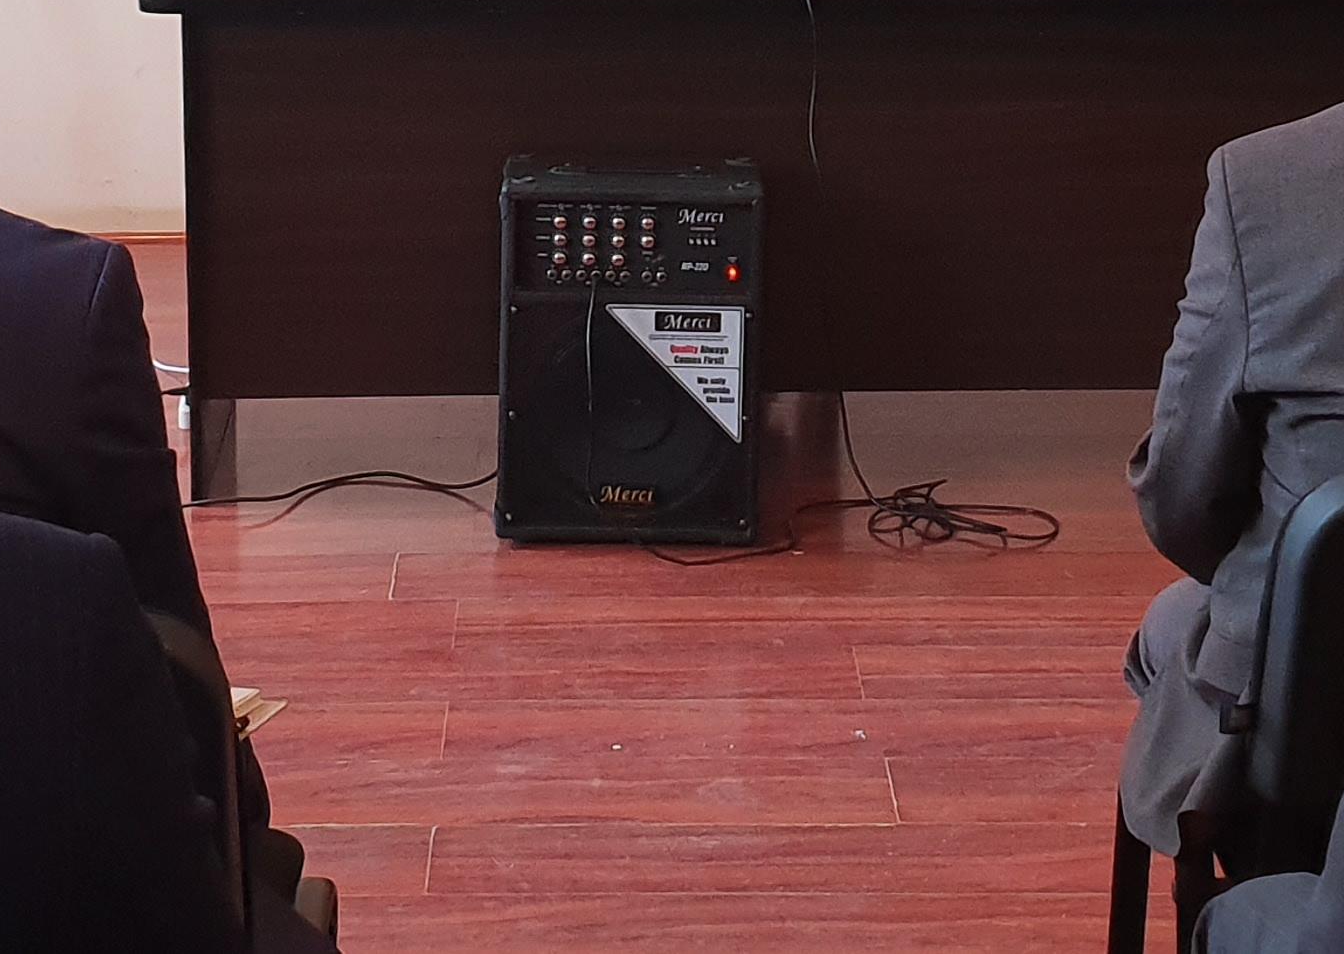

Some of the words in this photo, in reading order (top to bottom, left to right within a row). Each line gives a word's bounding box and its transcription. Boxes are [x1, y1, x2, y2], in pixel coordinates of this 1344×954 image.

[678, 208, 723, 224] Merci
[663, 313, 712, 330] Merci
[600, 485, 653, 502] Merci
